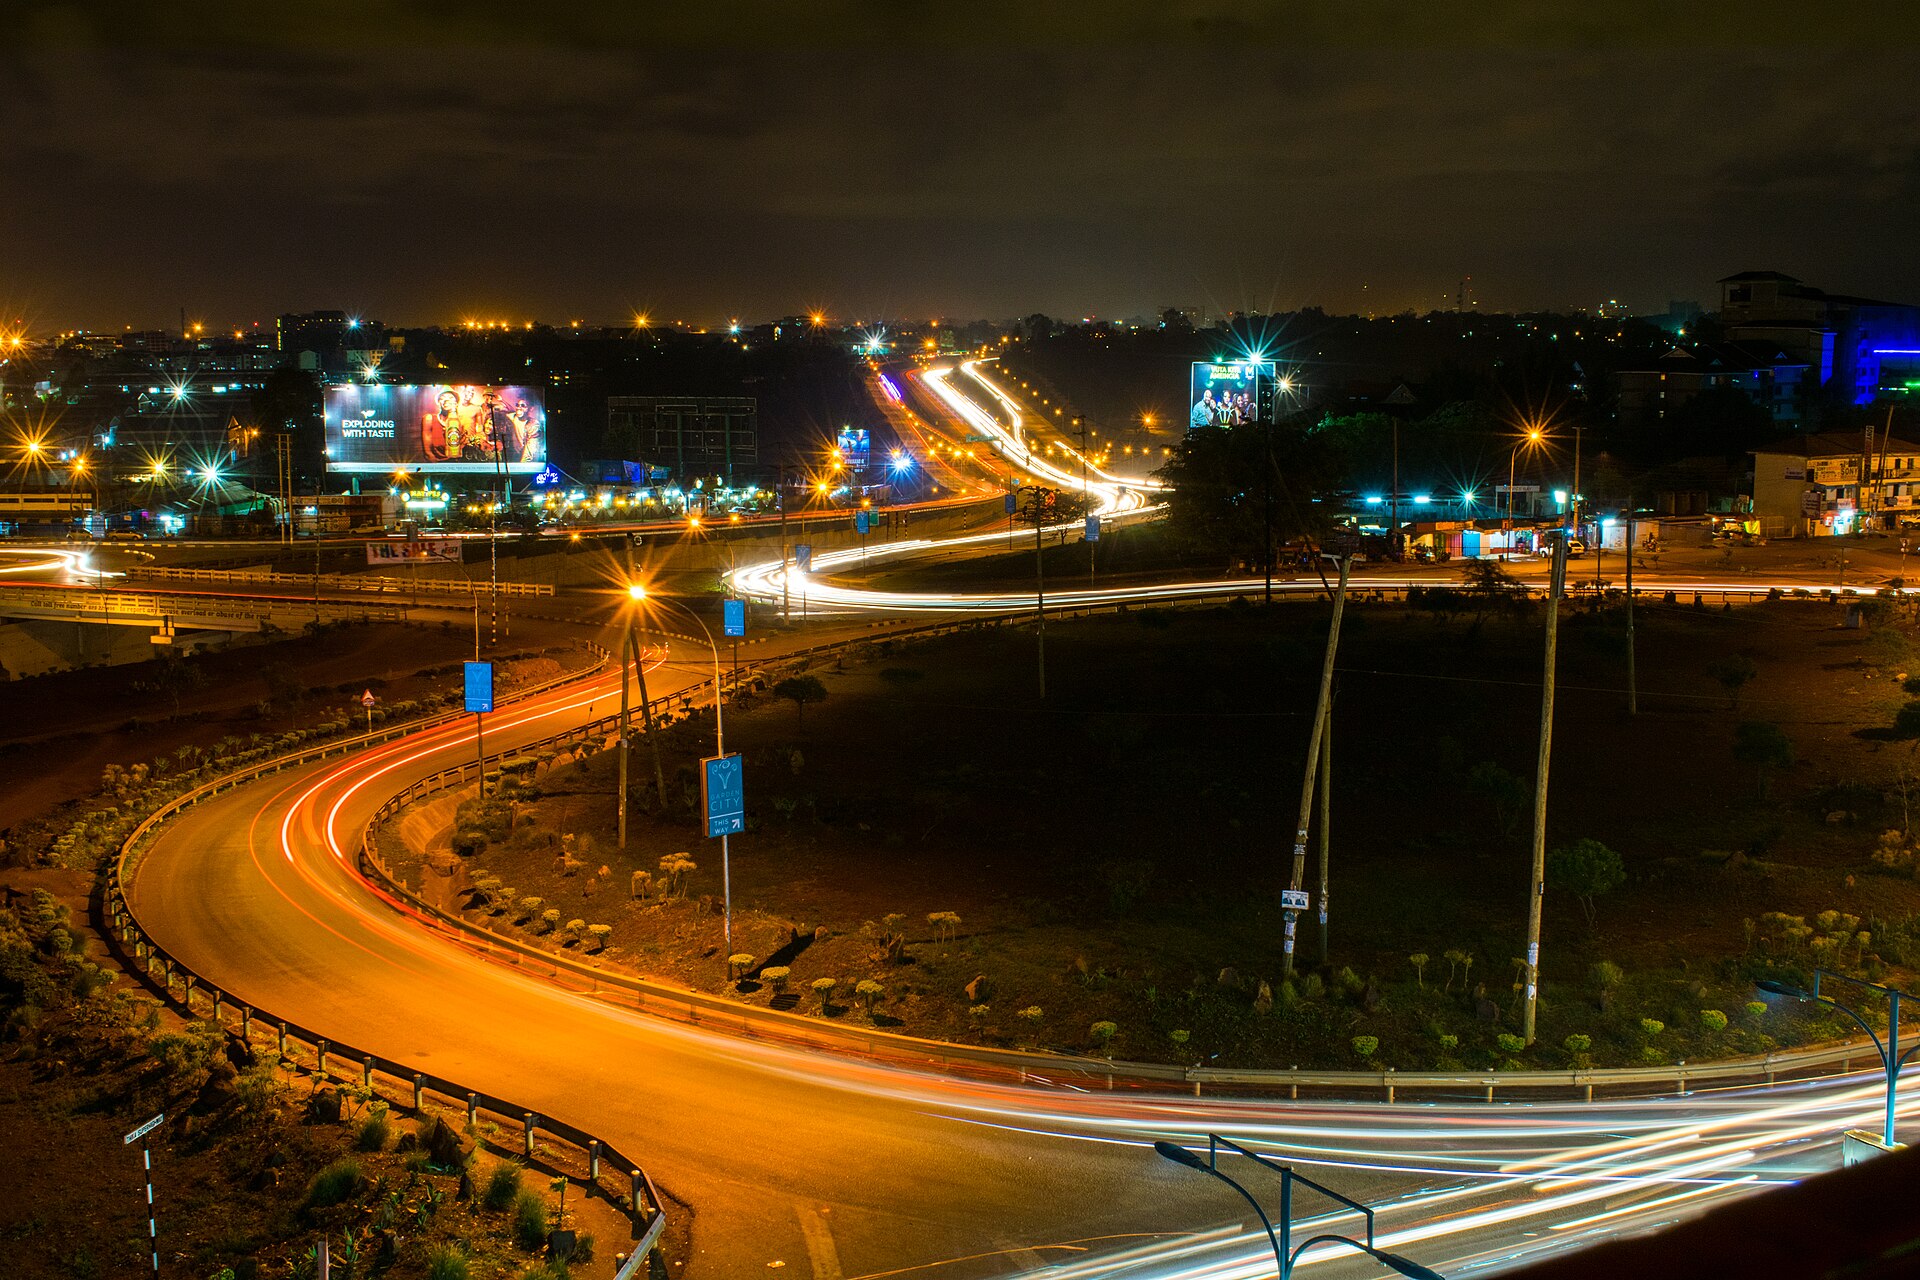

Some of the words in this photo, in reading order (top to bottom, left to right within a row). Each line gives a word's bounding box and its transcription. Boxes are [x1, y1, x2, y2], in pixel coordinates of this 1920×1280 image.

[342, 420, 395, 429] EXPLODING
[342, 429, 366, 438] WITH
[367, 429, 395, 438] TASTE
[1841, 467, 1858, 475] SONY
[369, 543, 399, 558] THE
[710, 789, 740, 801] GARDEN
[710, 797, 740, 811] CITY
[714, 818, 729, 827] THIS
[714, 827, 729, 835] WAY
